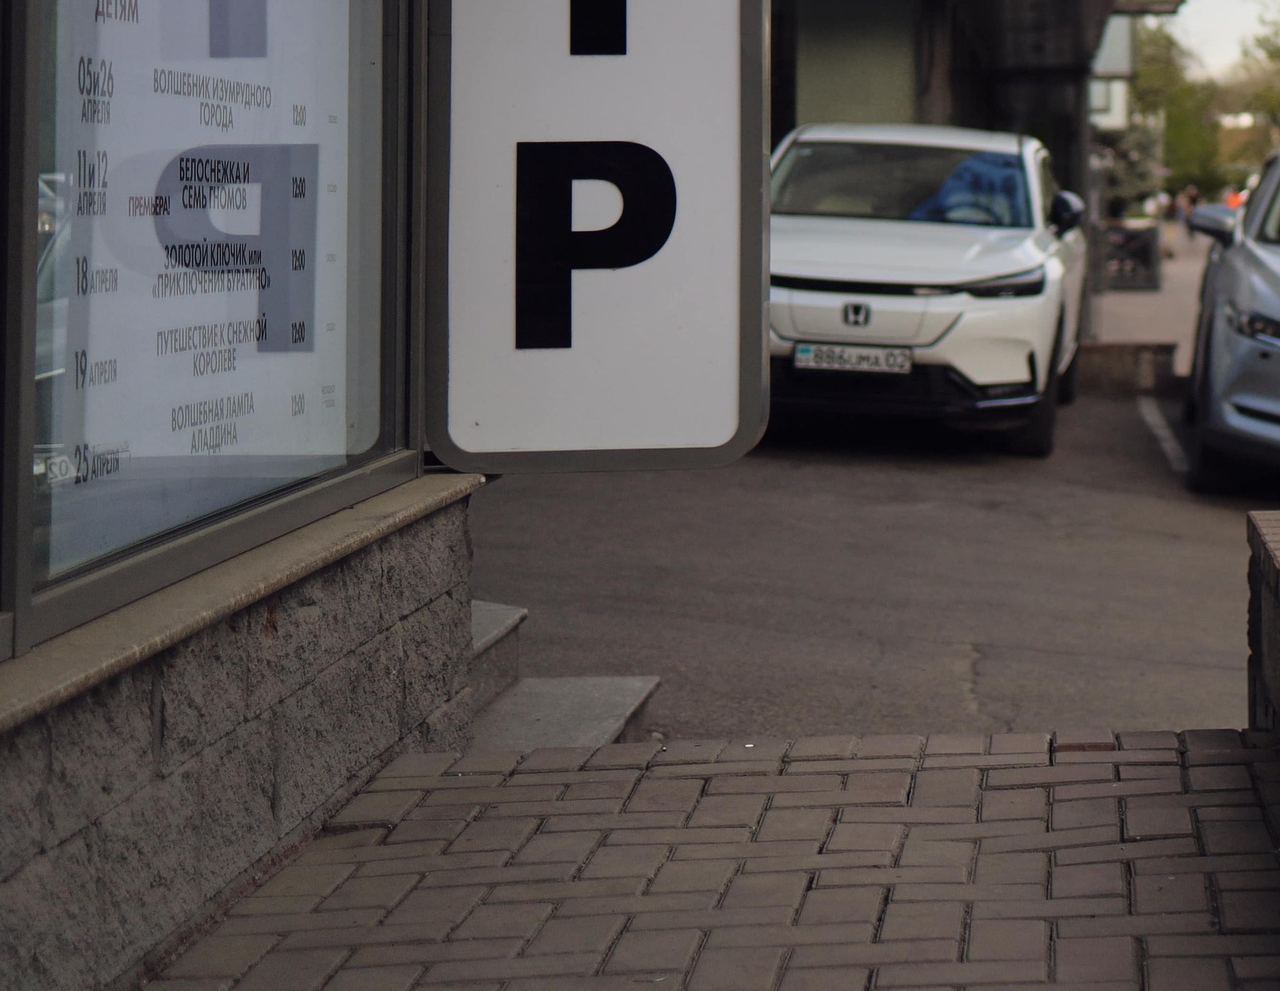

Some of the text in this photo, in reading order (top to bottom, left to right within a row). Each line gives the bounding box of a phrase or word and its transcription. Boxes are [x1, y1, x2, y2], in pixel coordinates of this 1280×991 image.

[153, 68, 272, 109] ВОЛШЕБНИК ИЗУМРУДНОГО
[80, 99, 110, 125] АПРЕЛЯ
[199, 101, 234, 132] ГОРОДА
[179, 157, 241, 184] БЕЛОСНЕЖКА
[76, 191, 107, 216] АПРЕЛЯ
[128, 194, 171, 217] ПРЕМЬЕРА!
[181, 184, 247, 210] СЕМЬ ГНОМОВ
[163, 237, 209, 271] ЗОЛОТОЙ
[210, 242, 248, 268] КЛЮЧИК
[76, 256, 118, 297] 18 АПРЕЛЯ
[152, 265, 271, 300] «ПРИКЛЮЧЕНИЯ БУРАТИНО»
[156, 322, 219, 357] ПУТЕШЕСТВИЕ
[227, 313, 268, 347] СНЕЖНОЙ
[74, 349, 118, 390] 19 АПРЕЛЯ
[192, 347, 237, 378] КОРОЛЕВЕ
[171, 391, 255, 433] ВОЛШЕБНАЯ ЛАМПА
[190, 422, 238, 456] АЛАДДИНА
[74, 443, 89, 484] 25
